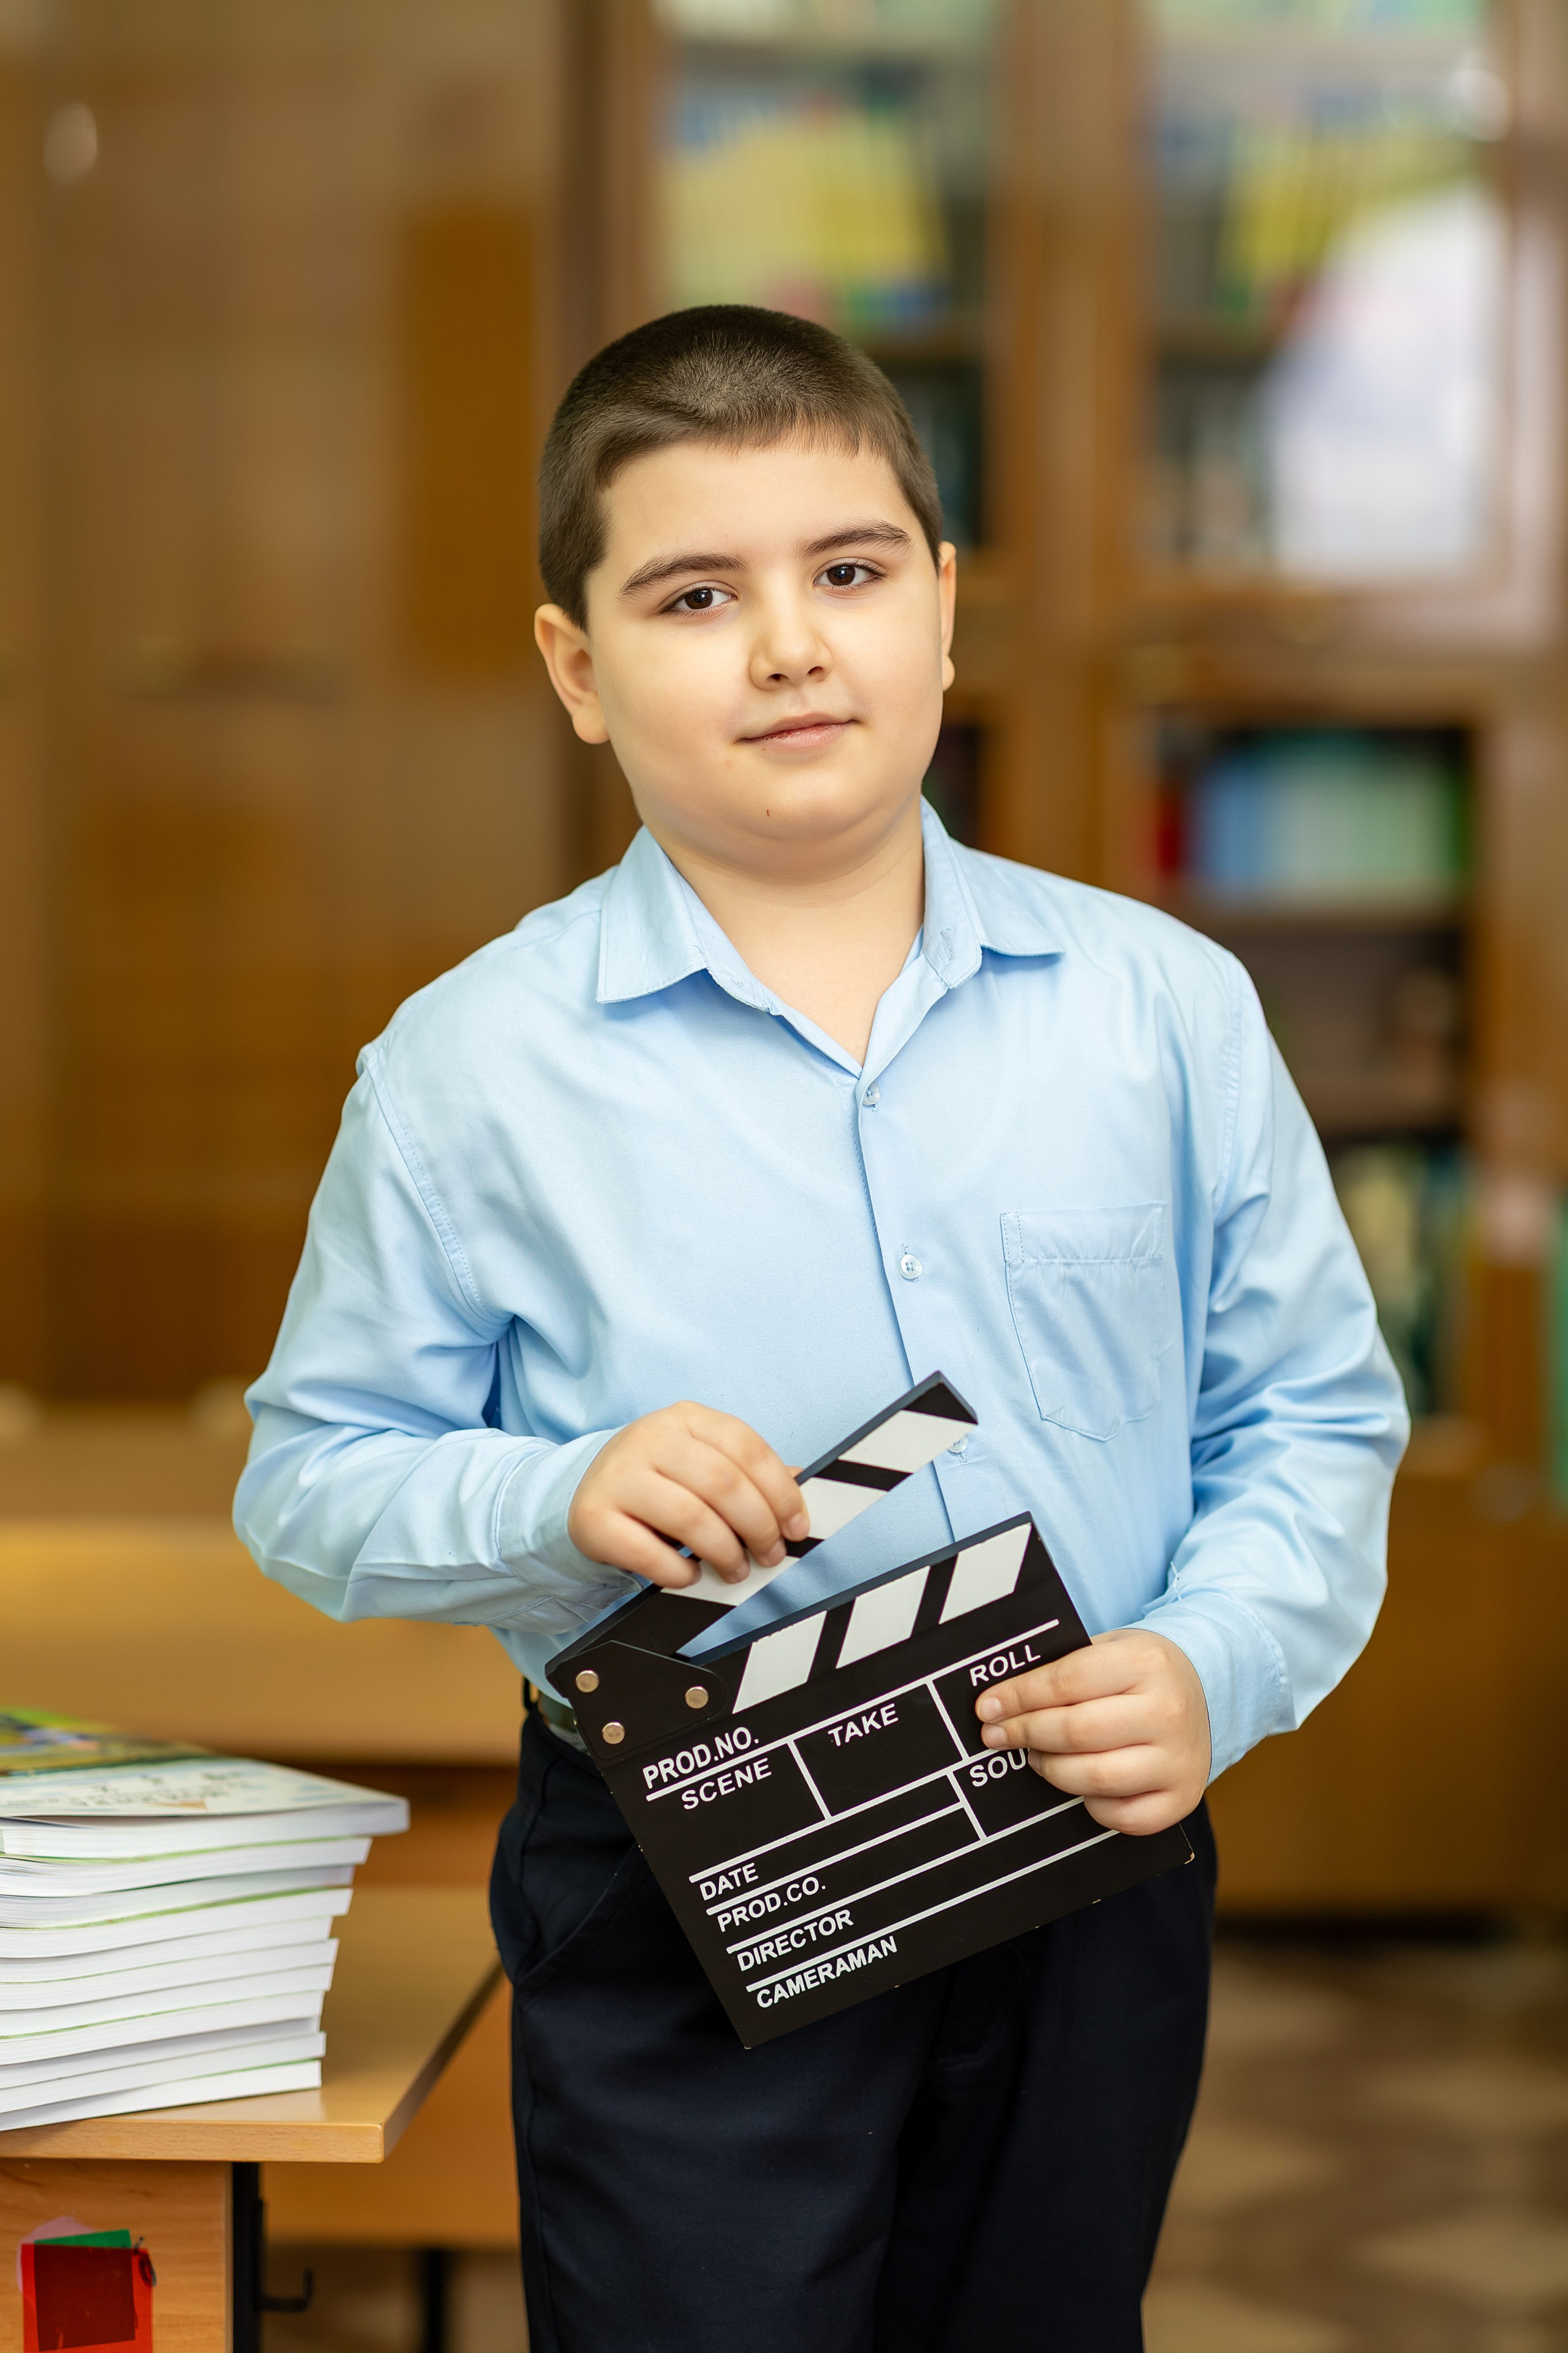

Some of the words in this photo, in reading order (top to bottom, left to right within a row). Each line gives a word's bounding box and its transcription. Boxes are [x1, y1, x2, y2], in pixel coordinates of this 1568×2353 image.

[970, 1645, 1041, 1686] ROLL
[827, 1703, 899, 1747] TAKE
[643, 1726, 760, 1789] PROD.NO.
[970, 1748, 1030, 1787] SOU
[681, 1758, 772, 1810] SCENE
[699, 1862, 759, 1901] DATE
[717, 1876, 826, 1932] PROD.CO.
[737, 1909, 854, 1971] DIRECTOR
[756, 1935, 897, 2008] CAMERAMAN
